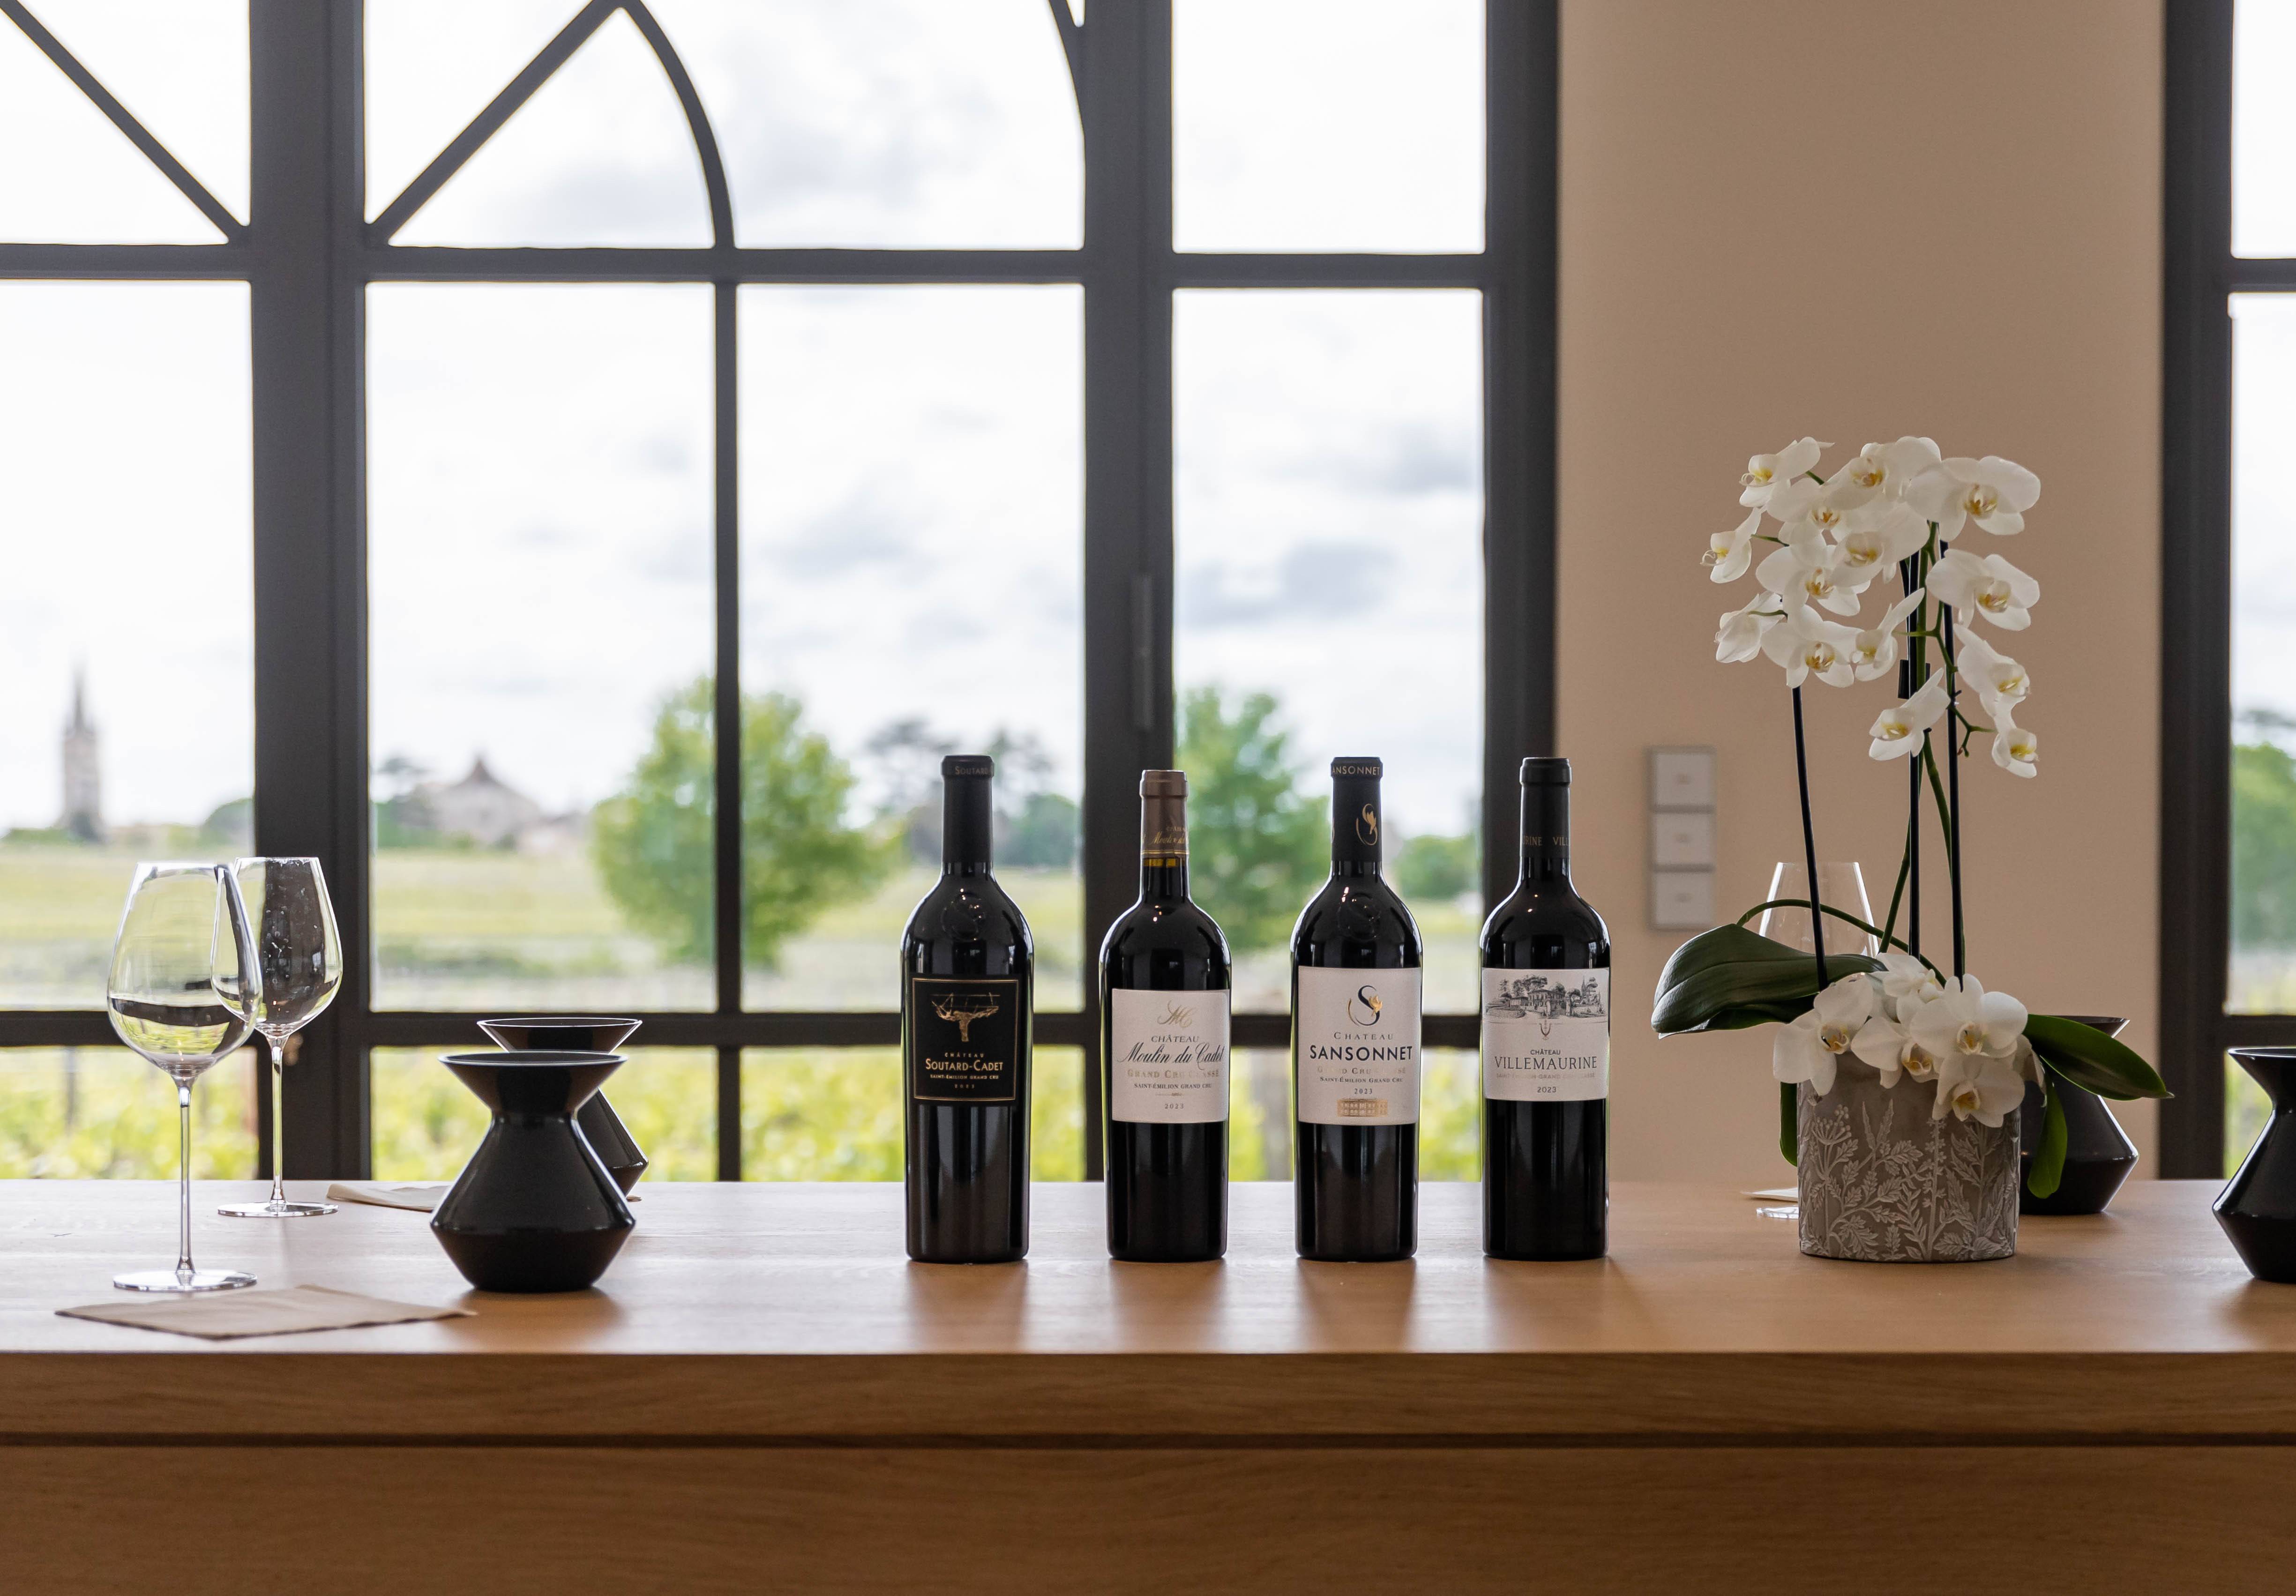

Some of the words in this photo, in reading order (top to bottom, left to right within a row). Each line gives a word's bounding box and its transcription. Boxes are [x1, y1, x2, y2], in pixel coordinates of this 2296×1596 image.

[1116, 1042, 1171, 1063] Moulin
[1173, 1045, 1193, 1063] du
[1310, 1045, 1413, 1061] SANSONNET
[926, 1058, 1003, 1071] SOUTARD-CADET
[1495, 1056, 1597, 1070] VILLEMAURINE
